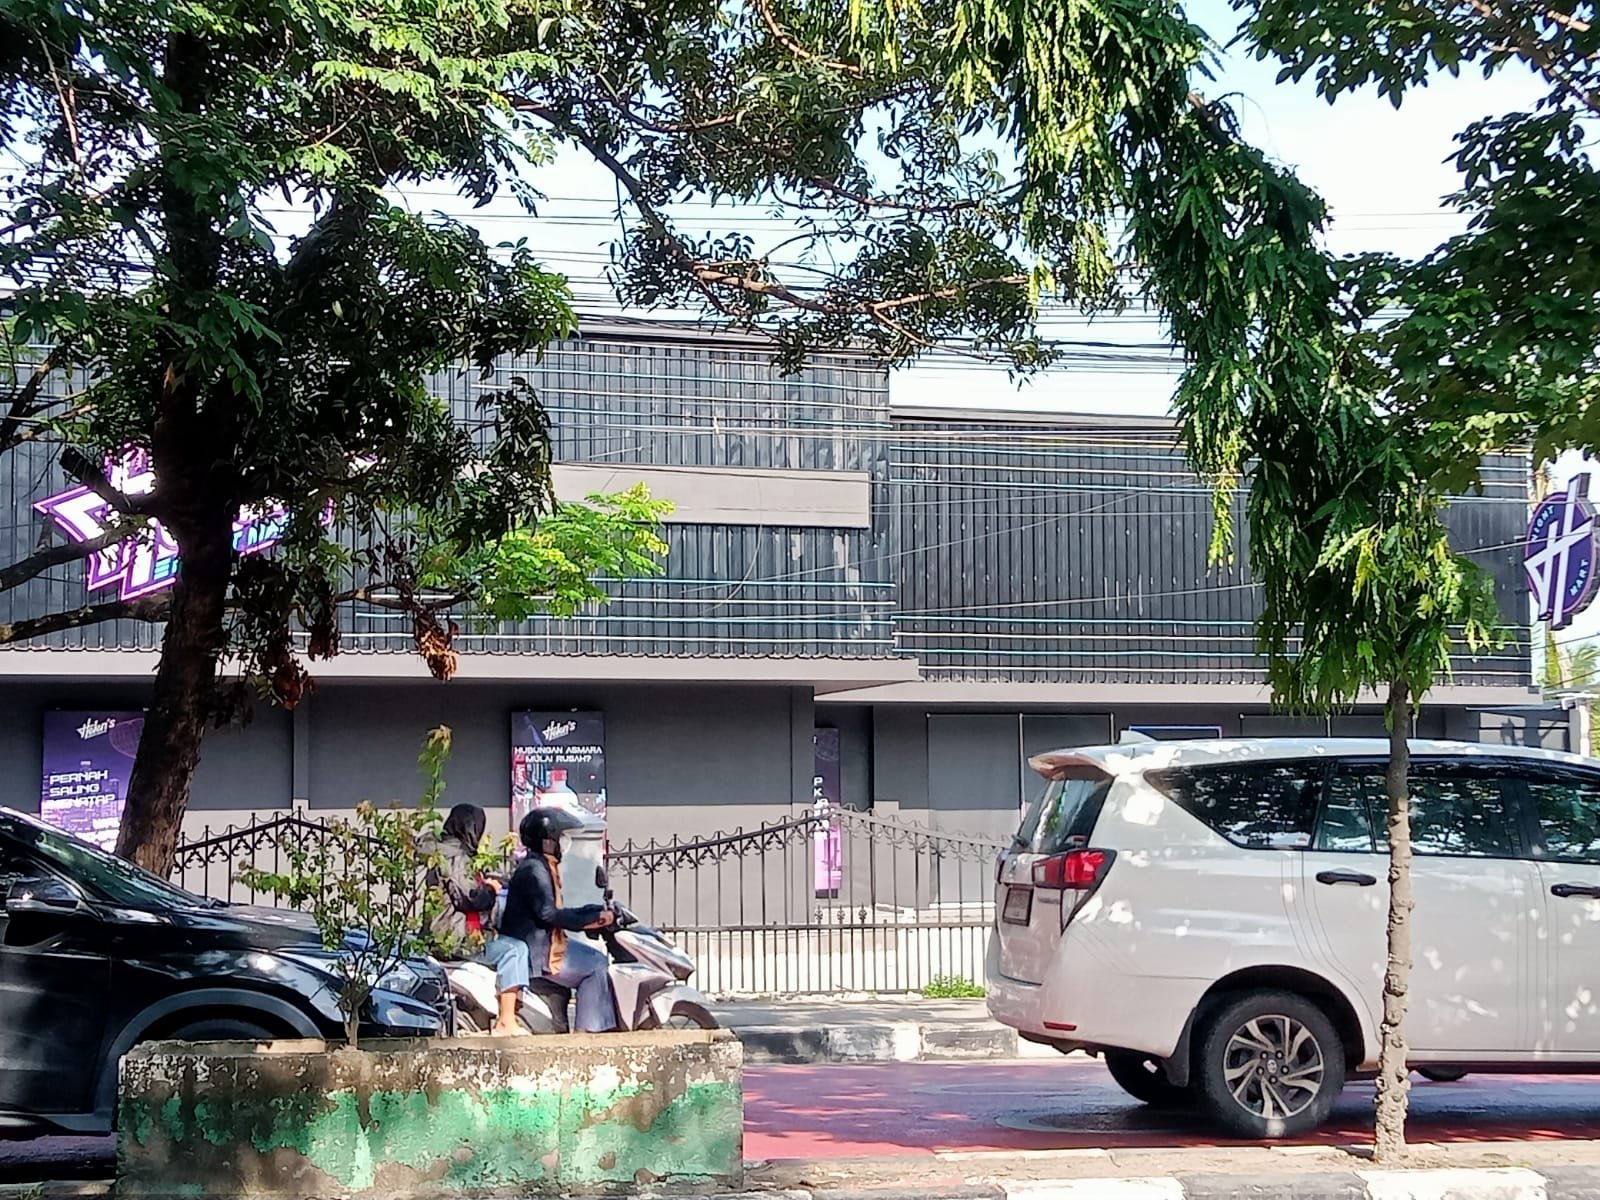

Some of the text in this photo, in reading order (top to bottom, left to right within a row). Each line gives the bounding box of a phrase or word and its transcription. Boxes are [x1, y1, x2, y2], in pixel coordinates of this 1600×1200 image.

[1569, 559, 1589, 596] MART
[76, 718, 116, 739] Helen's
[514, 746, 602, 754] HUBUNGAN ASMARA
[525, 755, 554, 763] MULAI
[50, 770, 108, 785] PERNAH
